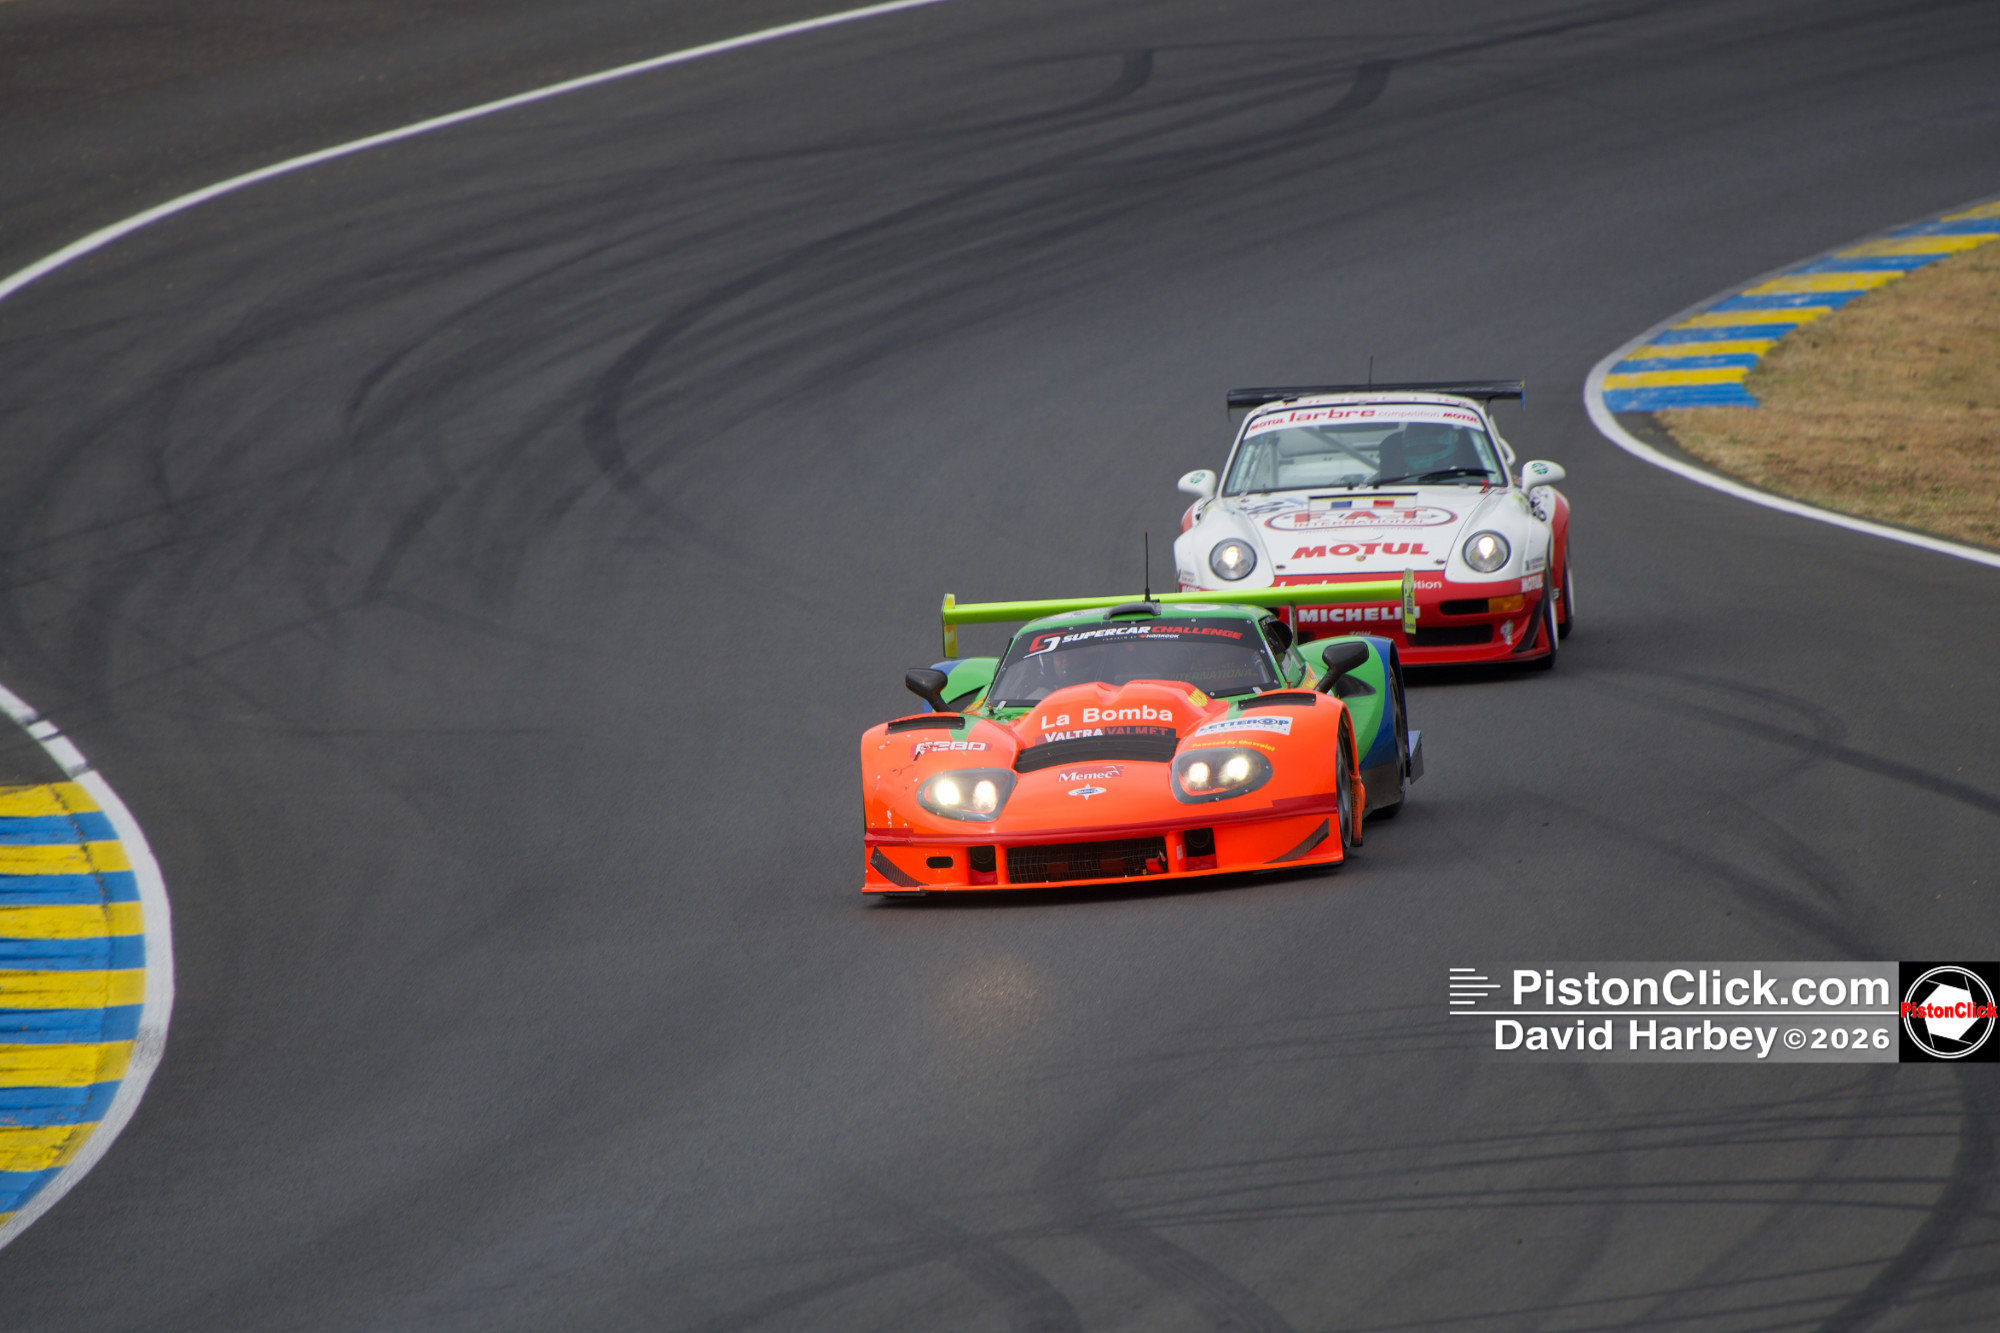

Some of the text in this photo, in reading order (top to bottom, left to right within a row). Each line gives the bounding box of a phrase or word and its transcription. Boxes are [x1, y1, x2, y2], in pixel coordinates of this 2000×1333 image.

[1288, 408, 1376, 422] larbre
[1294, 509, 1427, 523] FAT
[1291, 543, 1430, 560] MOTUL
[1061, 625, 1243, 643] SUPERCAR CHALLENGE
[1041, 705, 1173, 730] La Bomba
[1044, 727, 1168, 742] VALTRA VALMET
[1058, 771, 1113, 782] Memec
